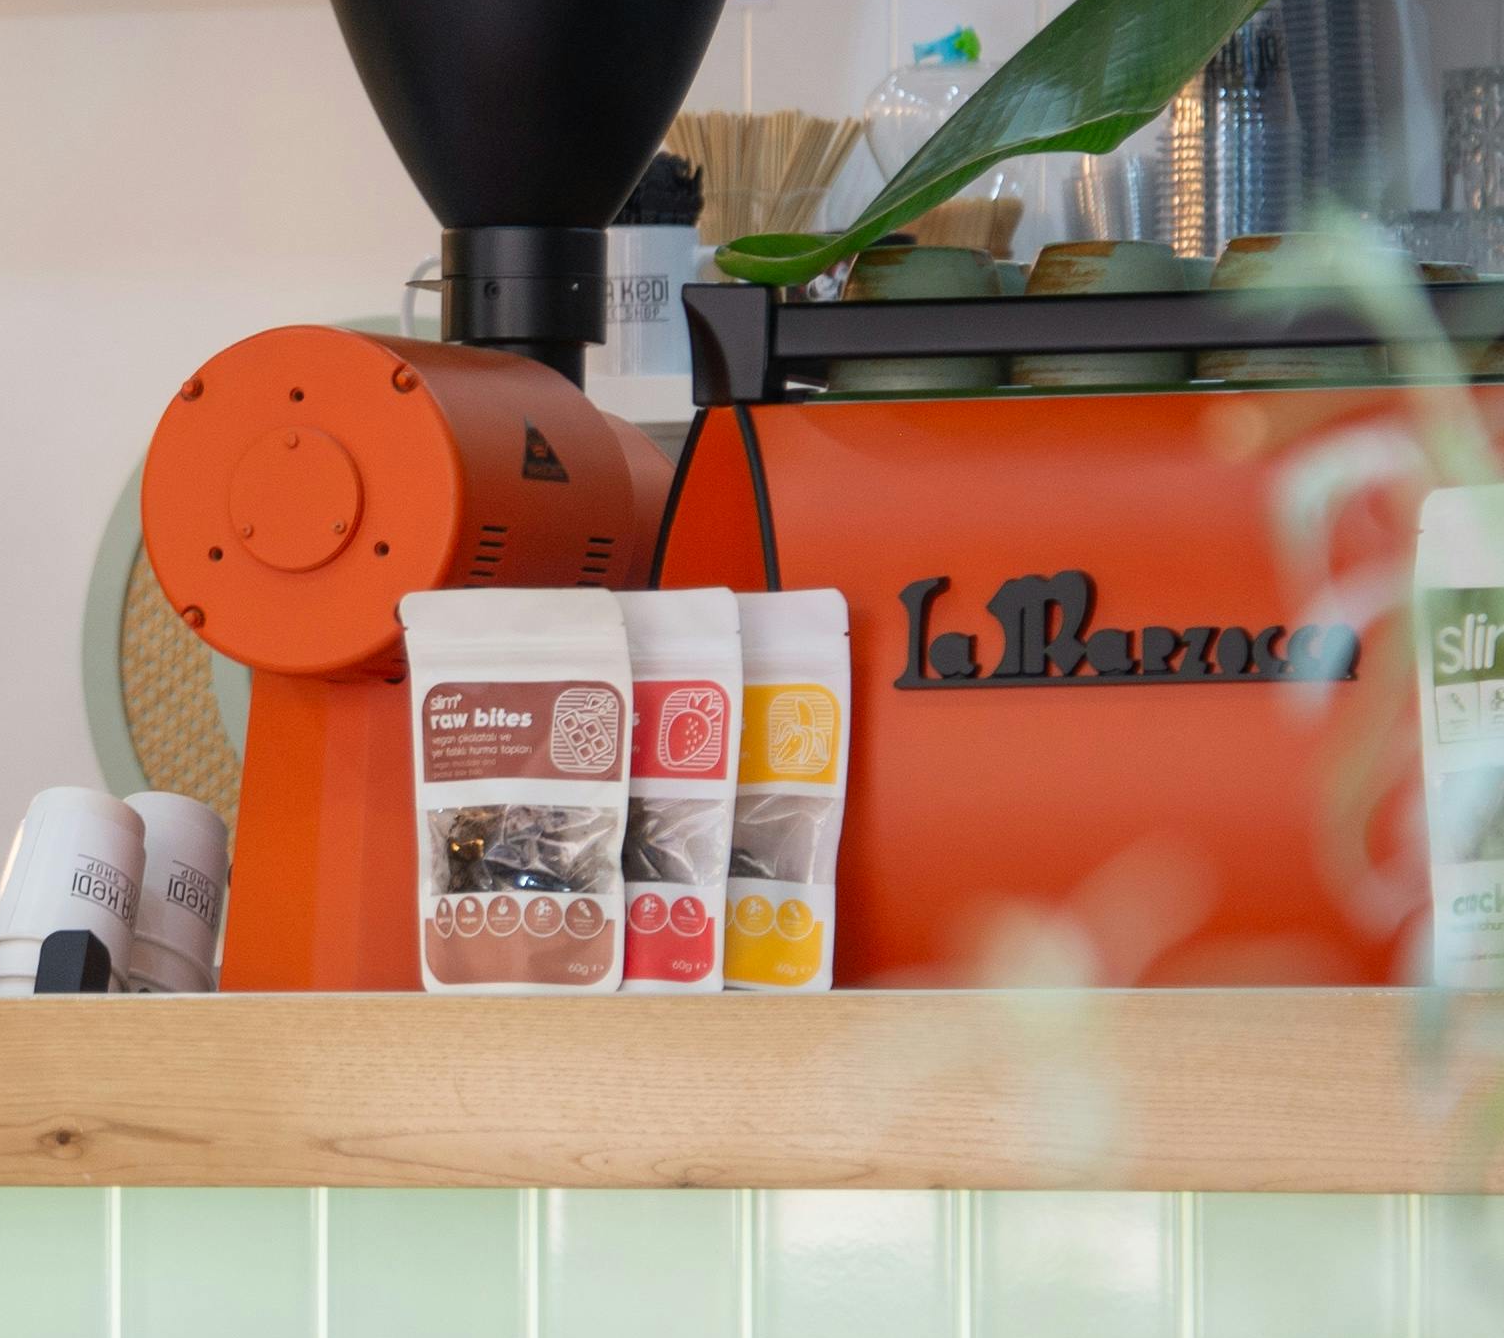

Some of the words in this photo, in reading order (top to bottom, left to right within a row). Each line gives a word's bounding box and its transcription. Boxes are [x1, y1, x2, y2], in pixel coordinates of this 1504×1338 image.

[430, 712, 468, 730] raw
[473, 707, 533, 728] bites
[568, 963, 589, 976] 60g
[672, 960, 693, 973] 60g
